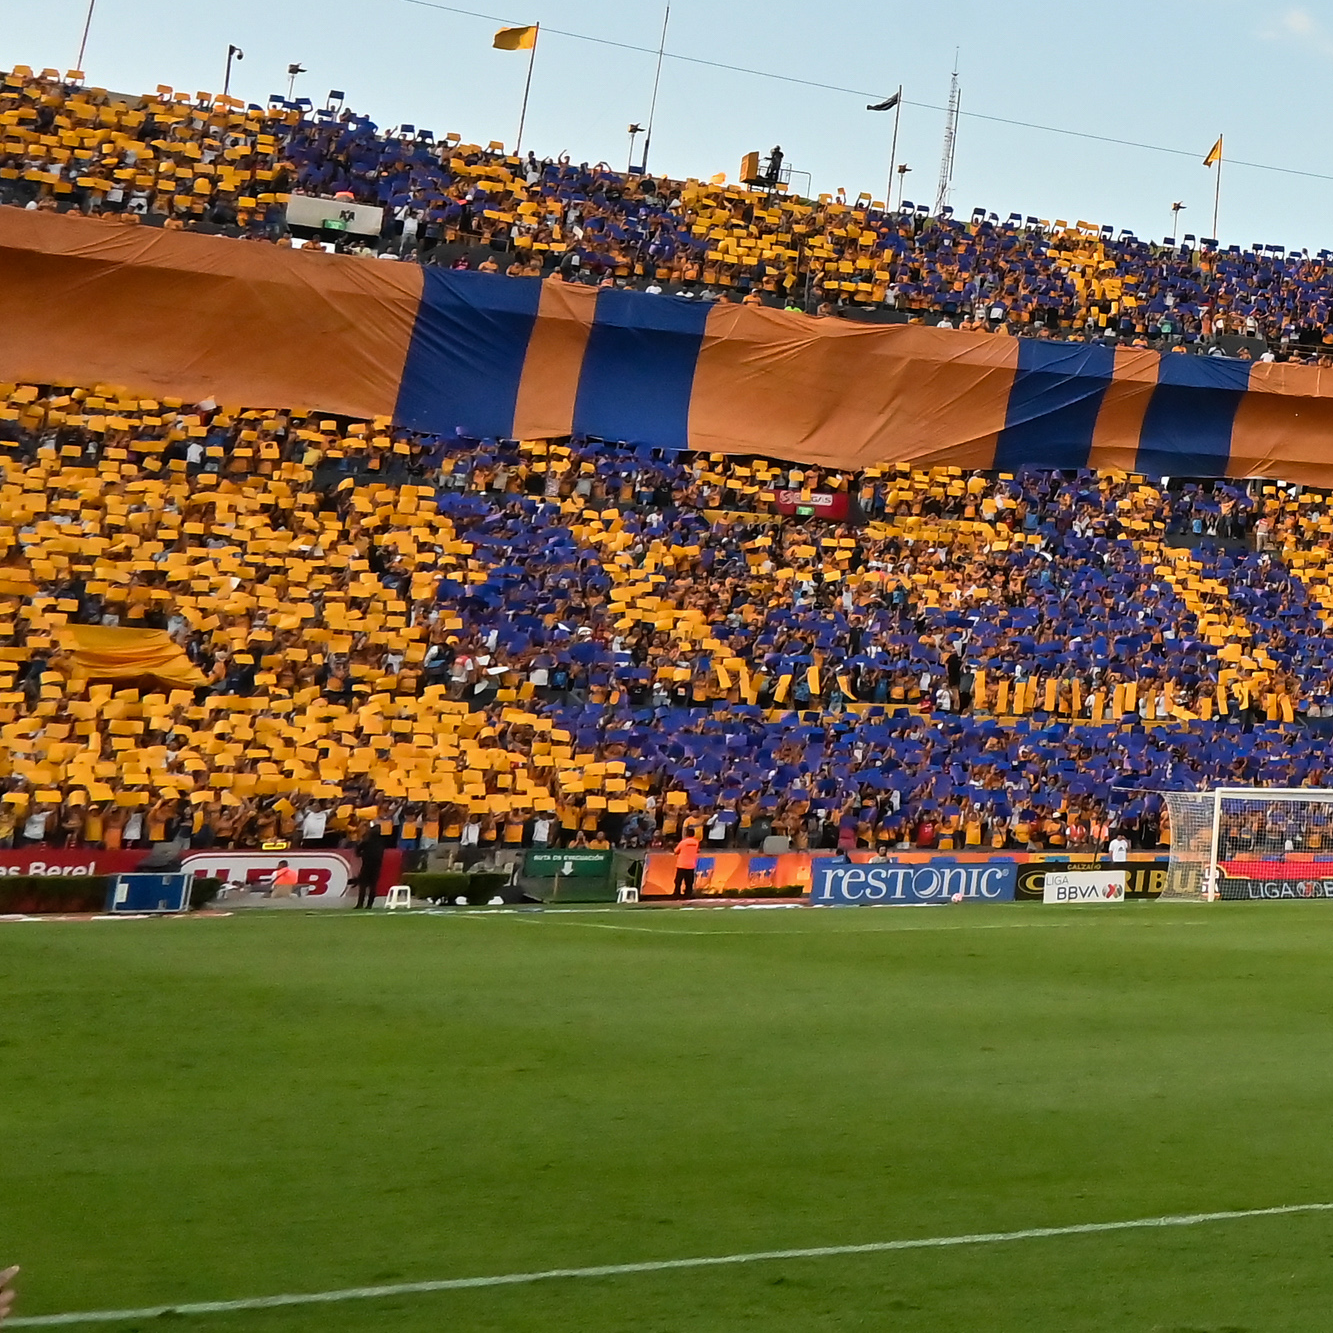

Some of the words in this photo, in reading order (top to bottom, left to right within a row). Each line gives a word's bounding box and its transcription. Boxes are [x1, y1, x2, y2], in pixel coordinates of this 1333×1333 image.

[29, 861, 95, 876] Berel
[1046, 875, 1069, 886] LIGA
[1057, 885, 1099, 901] BBVA
[1249, 882, 1295, 898] LIGA
